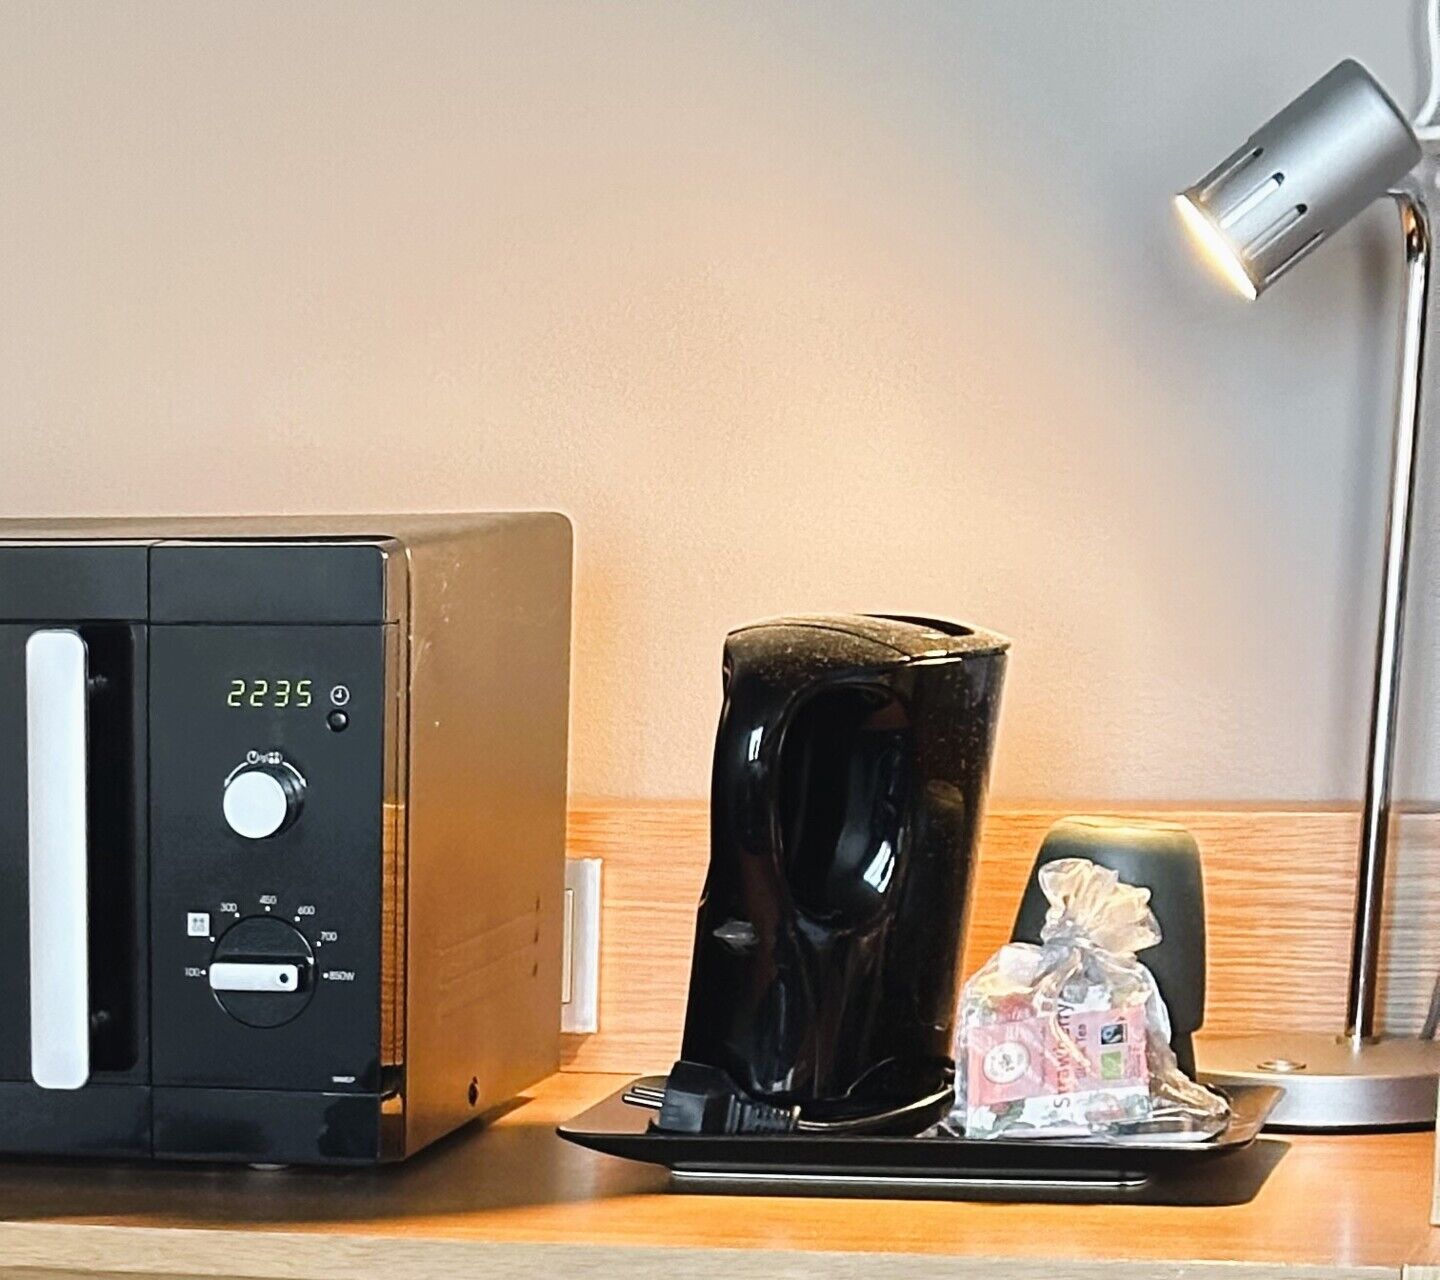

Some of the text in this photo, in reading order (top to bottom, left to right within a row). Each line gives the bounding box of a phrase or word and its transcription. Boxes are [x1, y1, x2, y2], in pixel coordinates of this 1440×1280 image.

[227, 679, 312, 707] 2235
[220, 903, 238, 913] 300
[320, 931, 338, 942] 700
